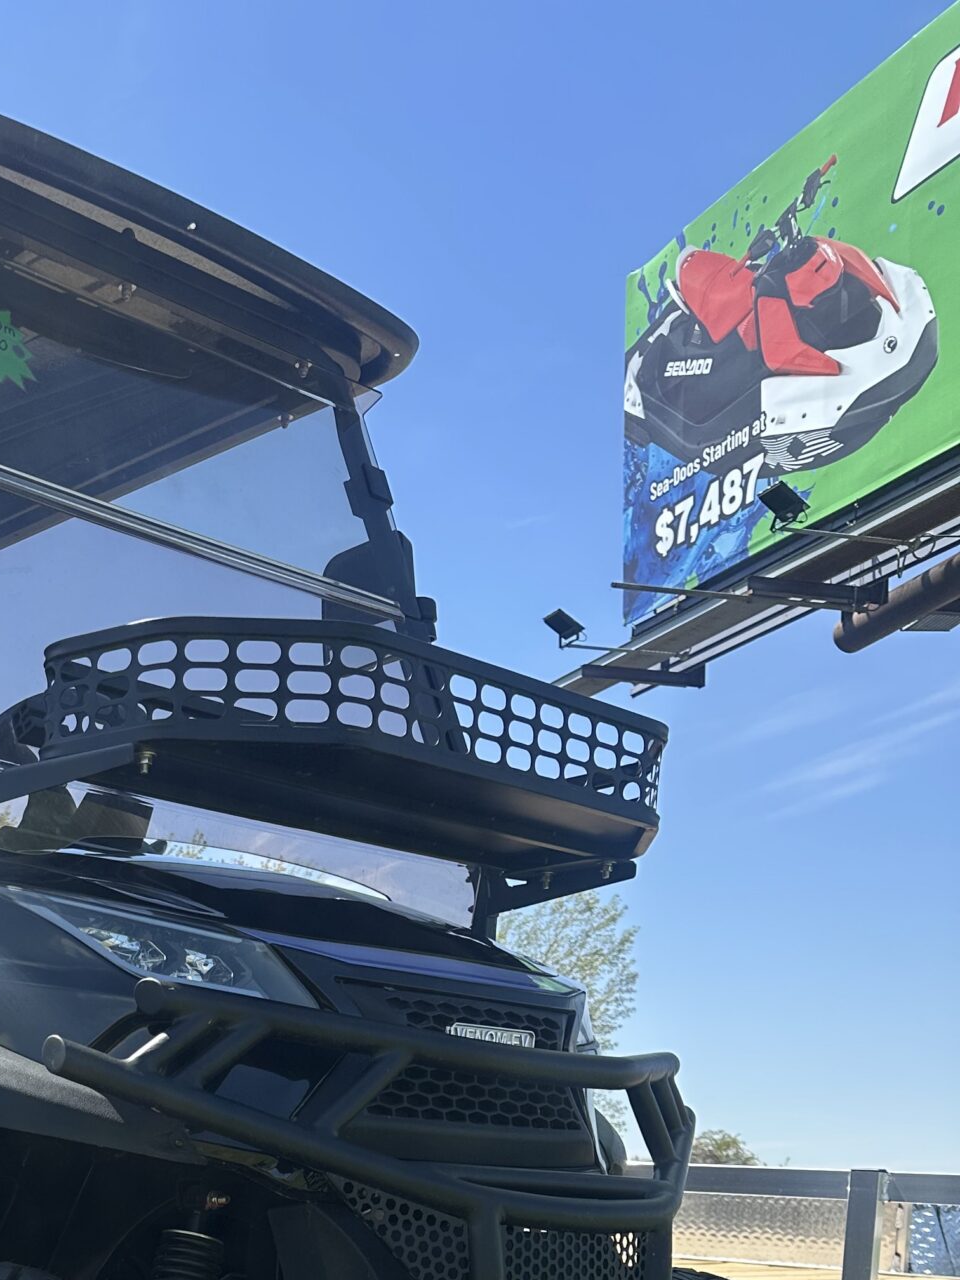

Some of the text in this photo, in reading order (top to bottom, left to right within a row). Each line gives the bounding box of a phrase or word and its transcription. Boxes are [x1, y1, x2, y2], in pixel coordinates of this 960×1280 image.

[650, 412, 767, 500] Sea-Doos Starting at
[655, 452, 765, 557] $7,487
